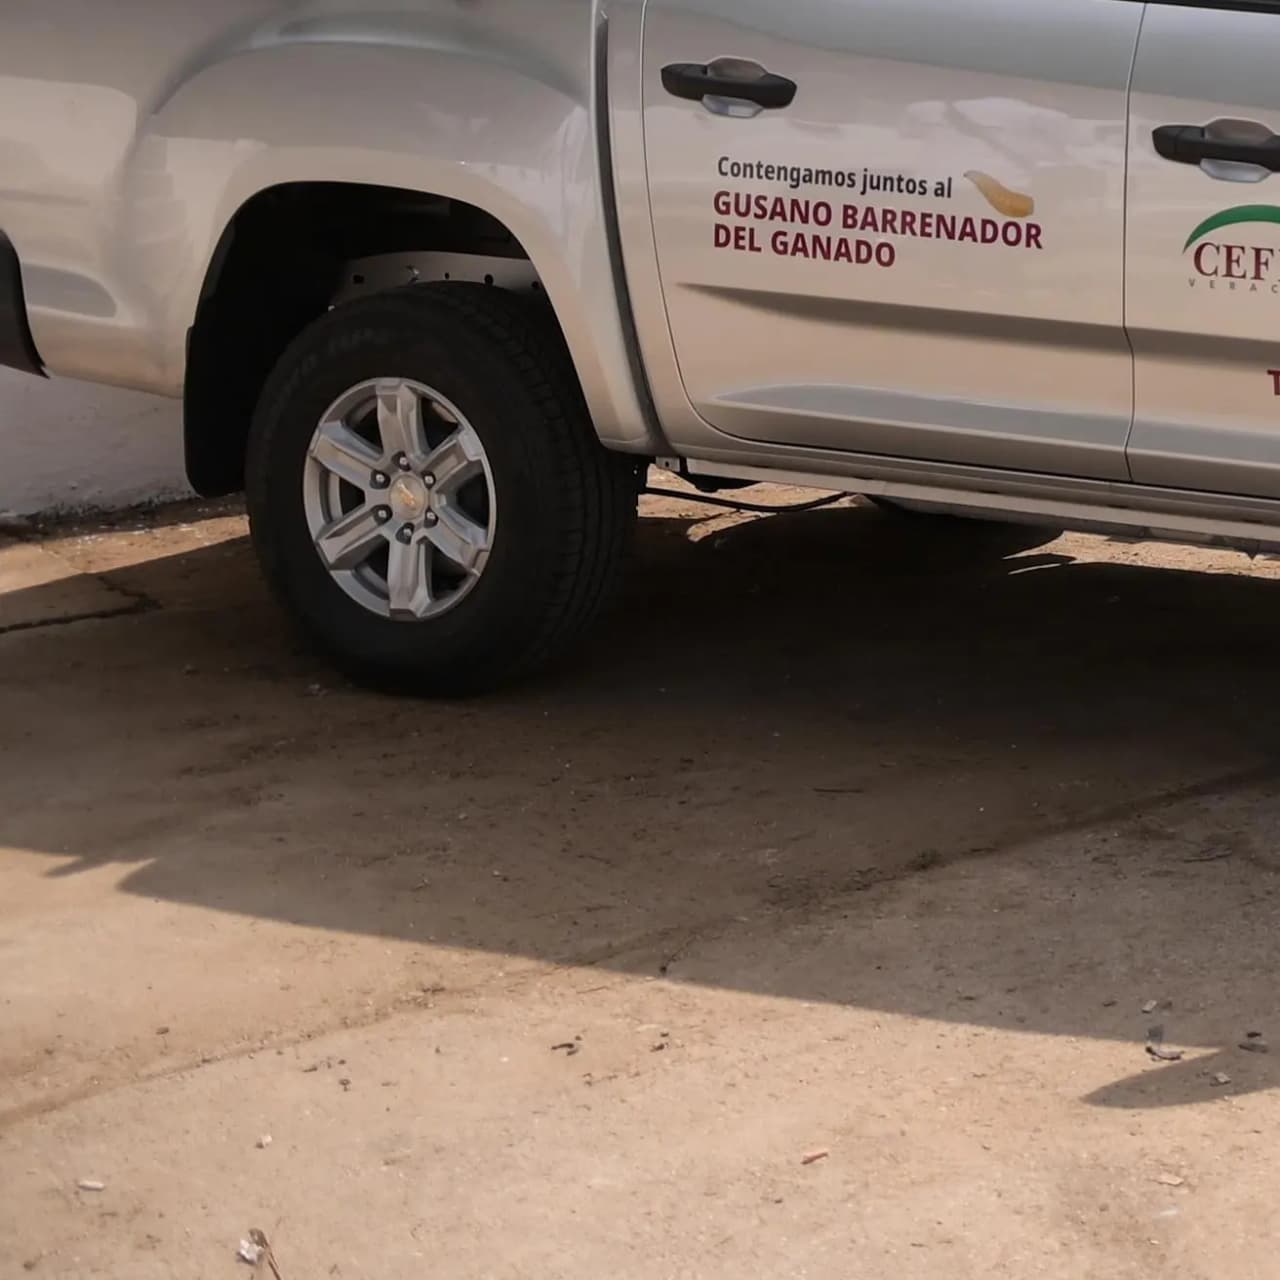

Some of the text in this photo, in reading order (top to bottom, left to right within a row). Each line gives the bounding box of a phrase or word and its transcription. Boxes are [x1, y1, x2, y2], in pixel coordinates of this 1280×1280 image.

[717, 155, 952, 198] Contengamos juntos al
[713, 190, 1043, 249] GUSANO BARRENADOR
[713, 223, 896, 268] DEL GANADO
